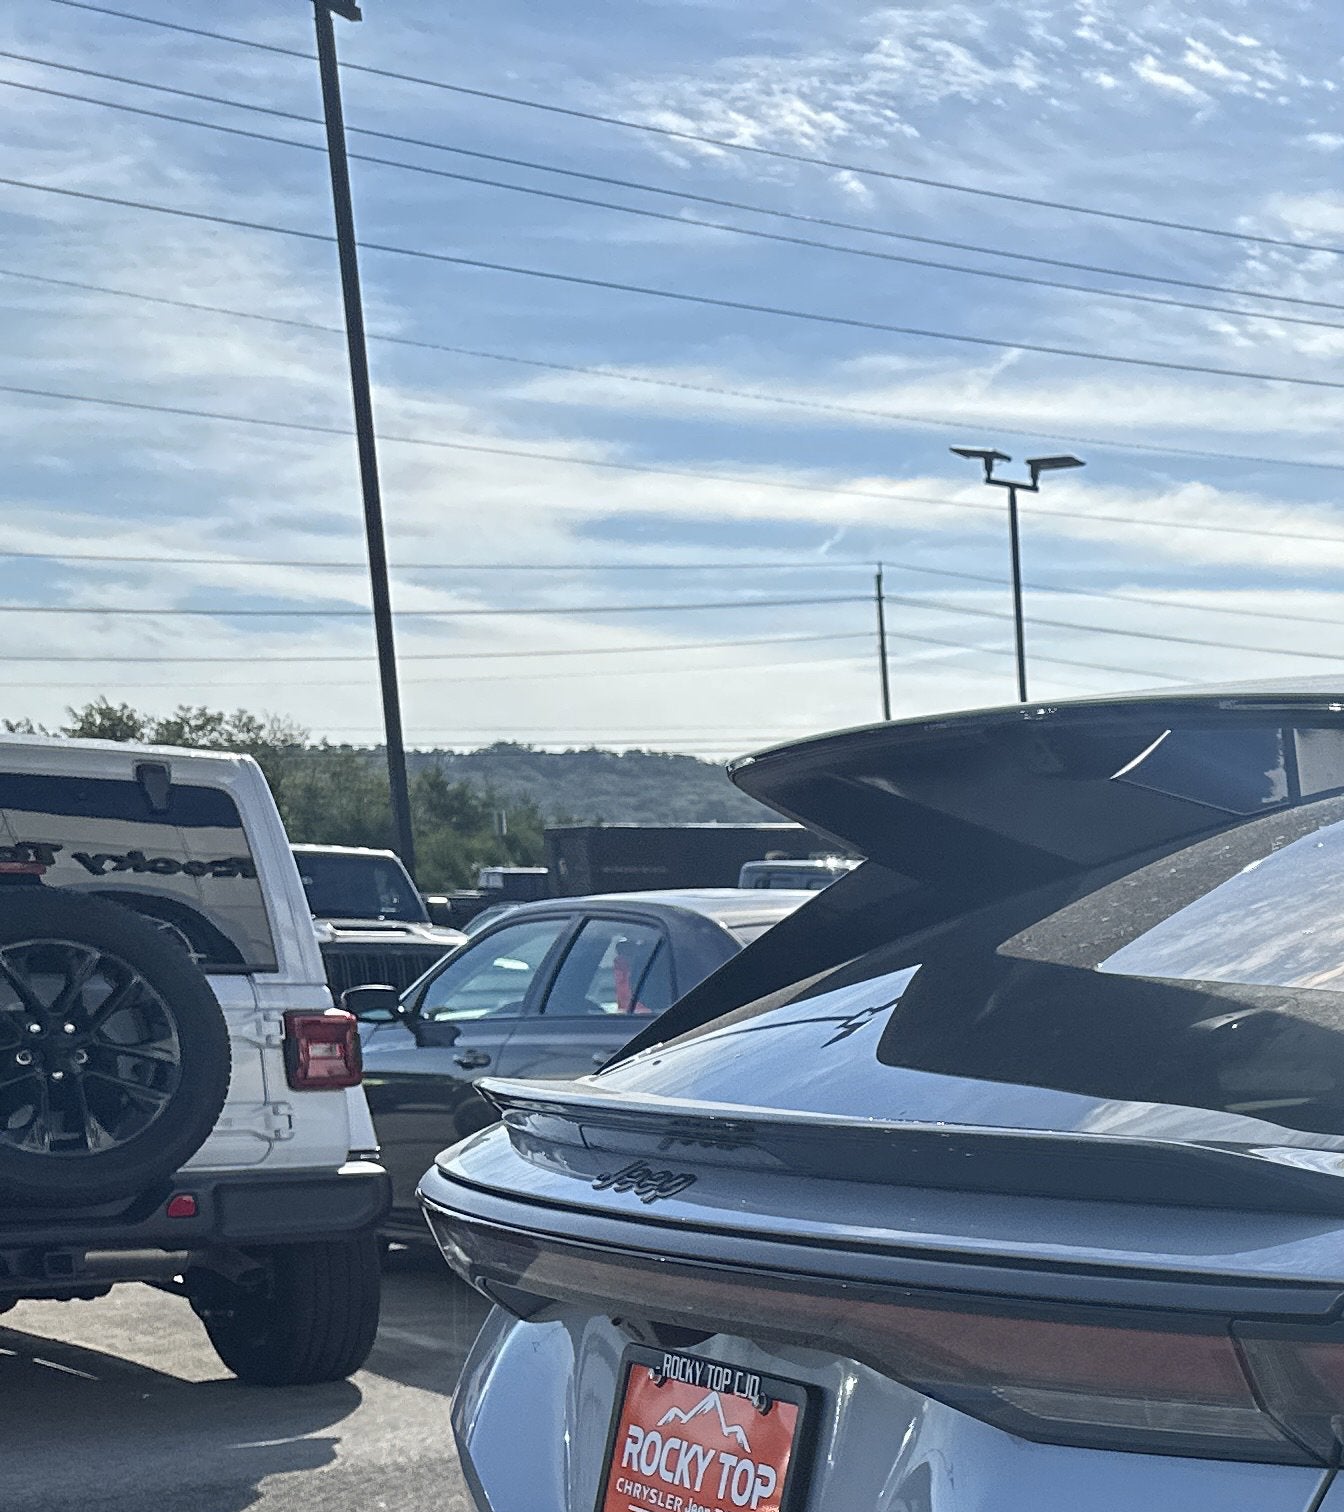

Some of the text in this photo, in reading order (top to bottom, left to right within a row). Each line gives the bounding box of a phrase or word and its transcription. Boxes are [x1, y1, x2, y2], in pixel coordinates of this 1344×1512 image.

[592, 1160, 698, 1205] Jeep
[662, 1353, 705, 1386] ROCKY
[707, 1364, 732, 1393] TOP
[621, 1424, 777, 1510] ROCKY TOP
